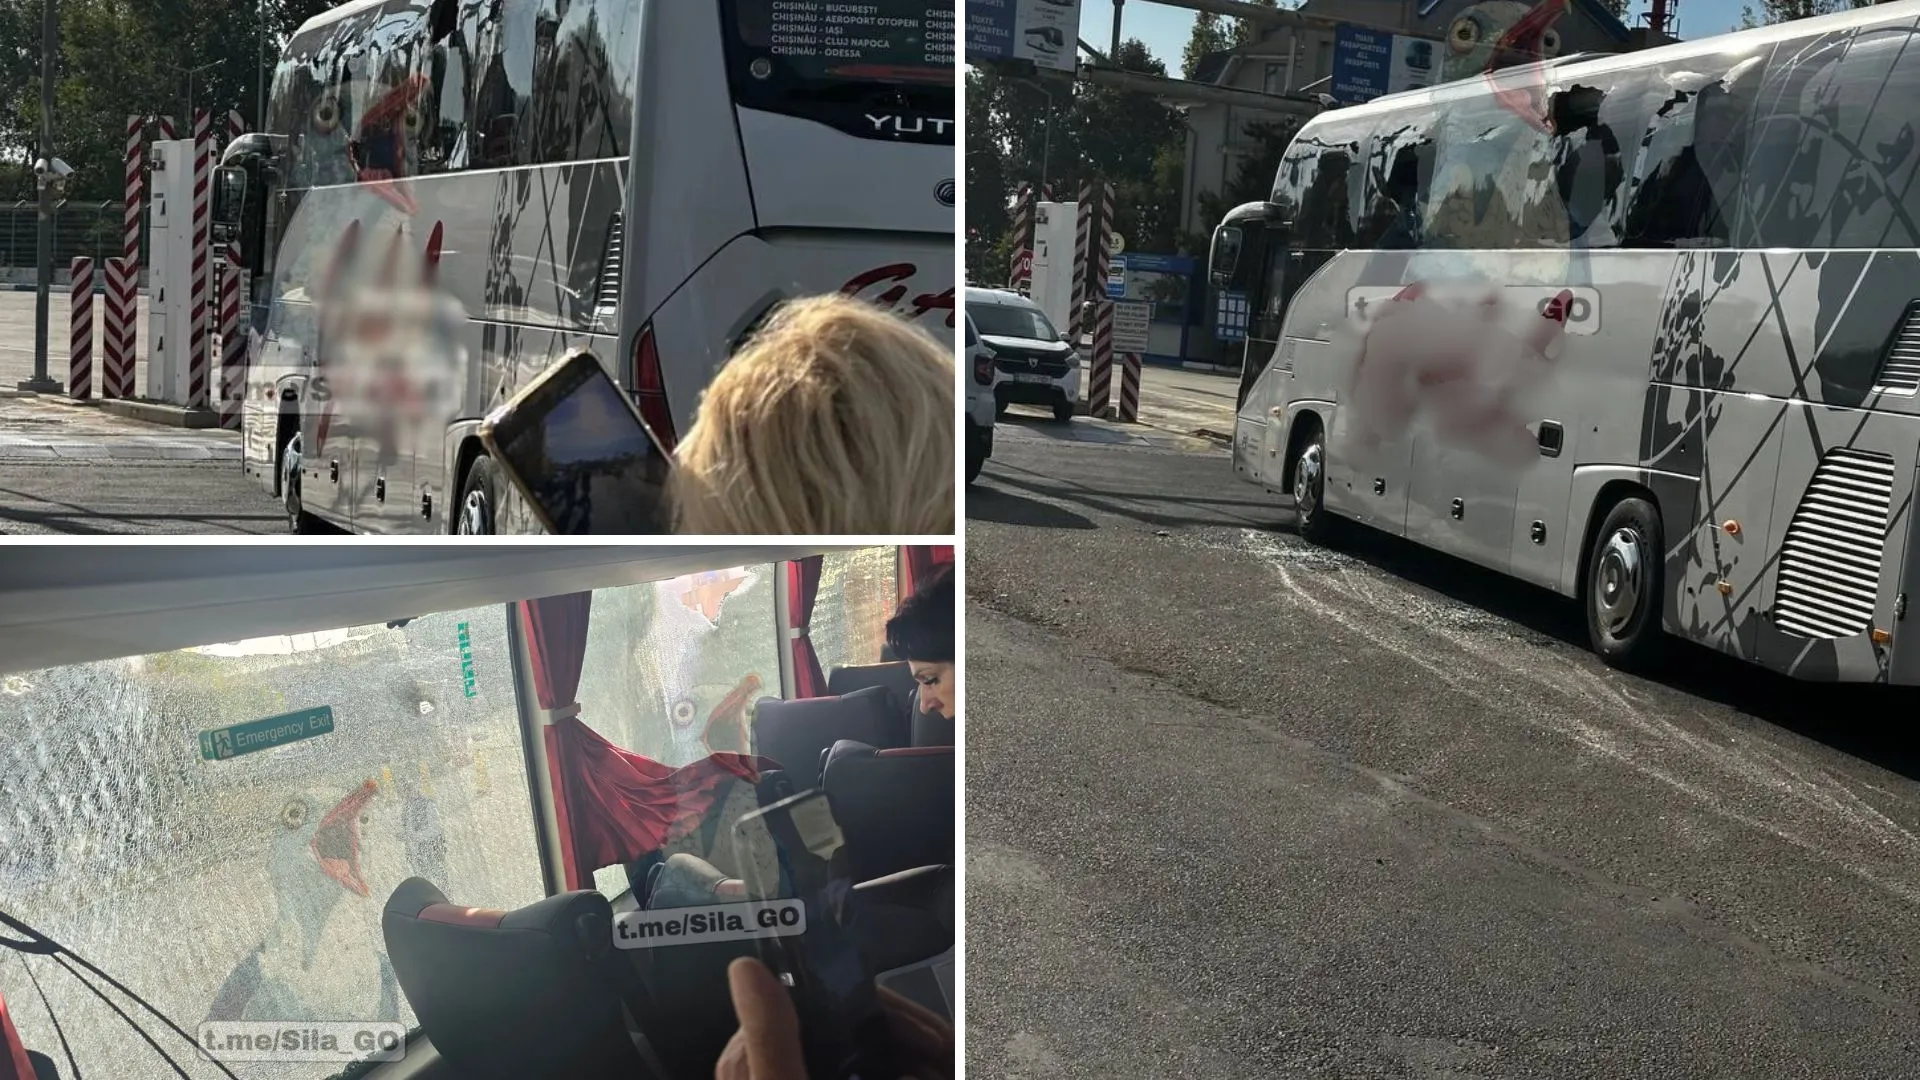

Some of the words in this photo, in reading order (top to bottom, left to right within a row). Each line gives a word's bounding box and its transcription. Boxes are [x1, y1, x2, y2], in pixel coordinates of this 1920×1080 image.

[825, 15, 875, 25] AEROPORT
[878, 18, 919, 28] OTOPENI
[825, 37, 849, 46] CLUJ
[851, 39, 890, 48] NAPOCA
[825, 48, 861, 58] ODESSA
[236, 721, 304, 747] Emergency
[309, 713, 331, 730] Exit
